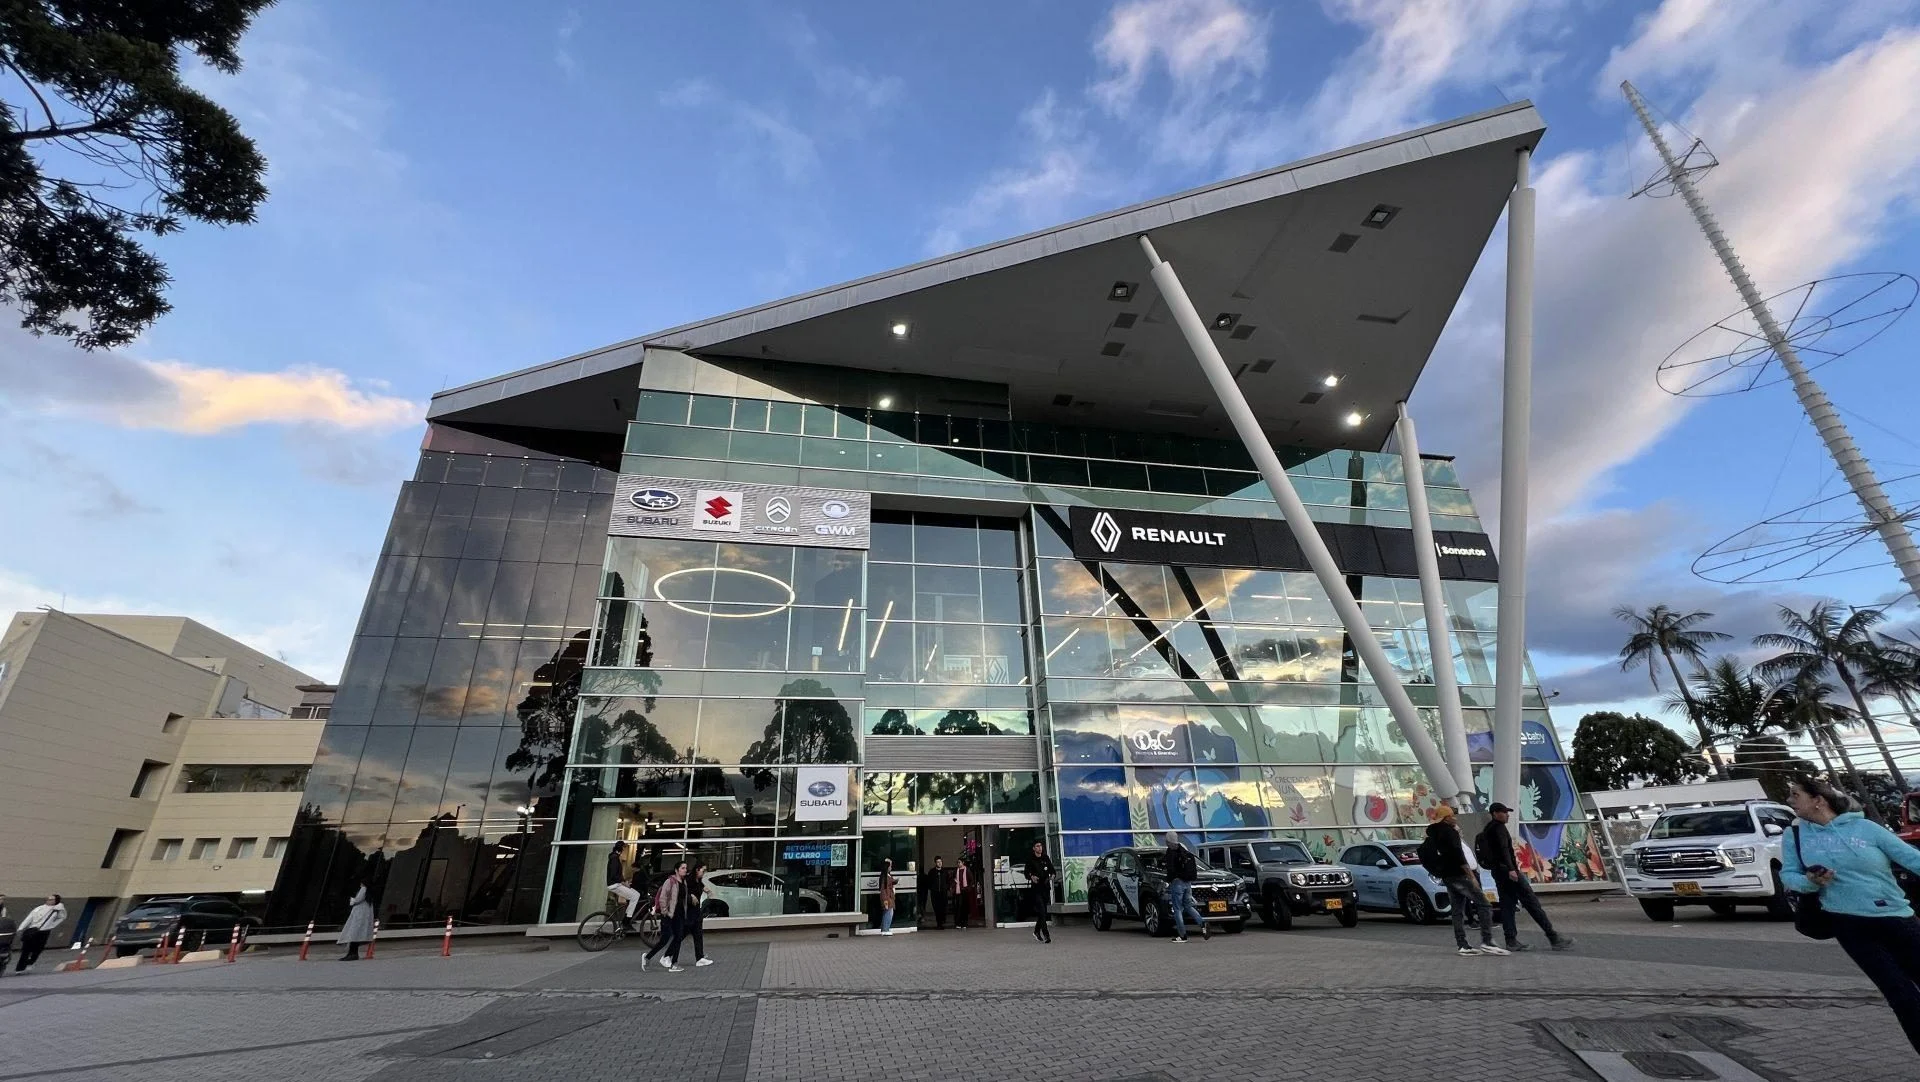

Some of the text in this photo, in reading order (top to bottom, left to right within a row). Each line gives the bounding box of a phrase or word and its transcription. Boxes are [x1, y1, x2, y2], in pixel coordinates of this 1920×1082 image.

[627, 515, 679, 526] SUBARU
[815, 524, 856, 536] GWM
[1131, 525, 1227, 546] RENAULT
[1441, 544, 1487, 557] Sanautos
[1525, 731, 1545, 744] baby
[800, 799, 842, 807] SUBARU
[786, 844, 832, 852] RETOMAMOS
